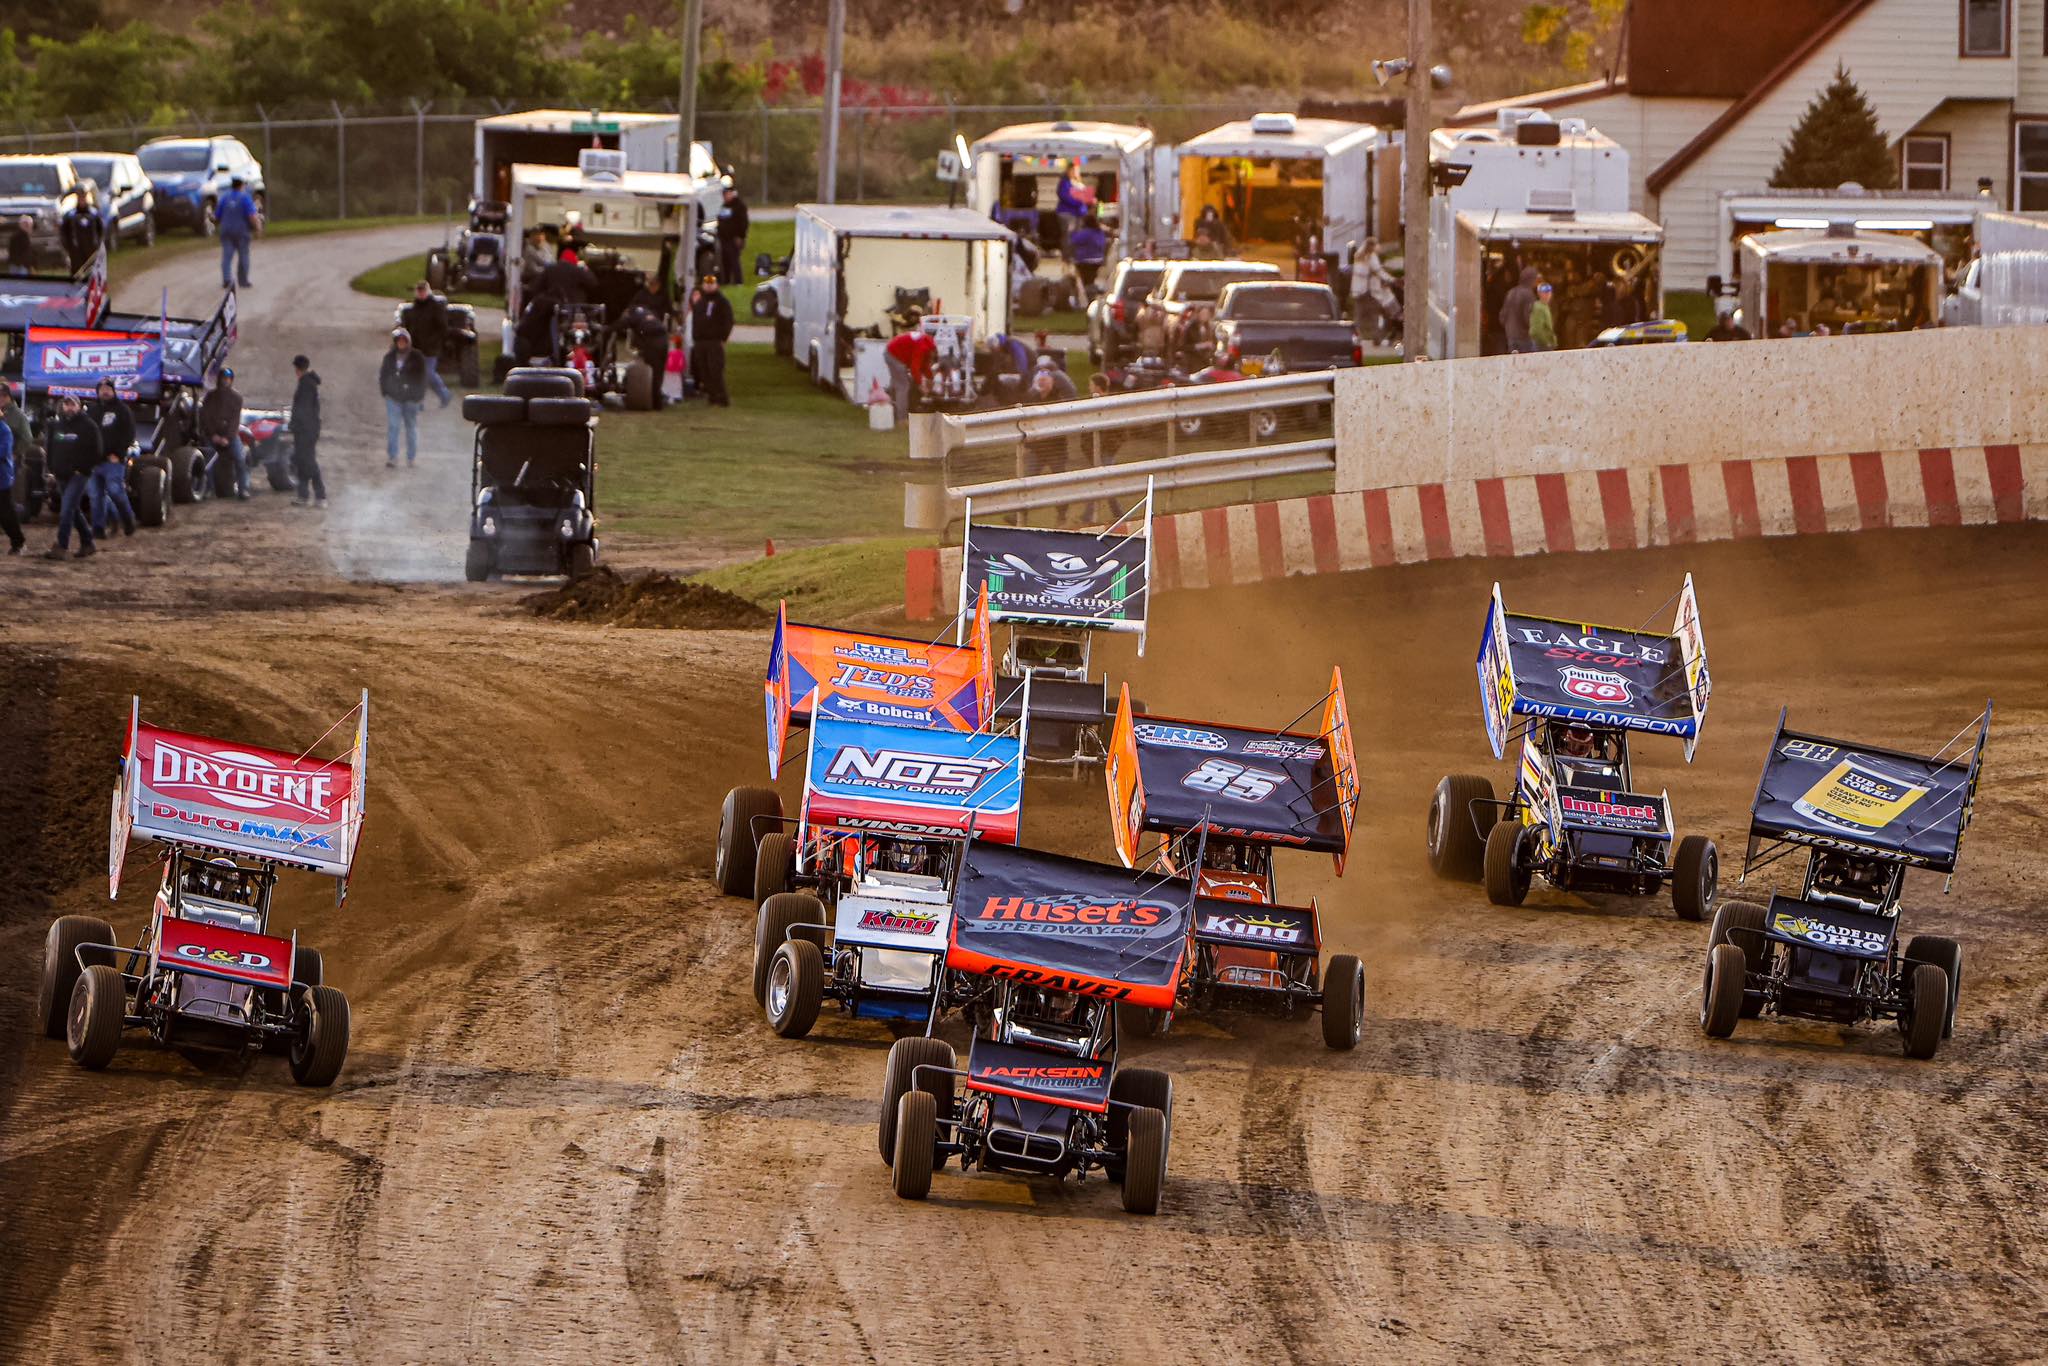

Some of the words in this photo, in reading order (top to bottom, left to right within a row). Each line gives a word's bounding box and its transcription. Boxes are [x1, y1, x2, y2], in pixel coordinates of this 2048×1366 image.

[42, 343, 154, 368] NOS
[988, 592, 1052, 604] YOUNG
[1069, 597, 1124, 609] GUNS
[1518, 628, 1665, 665] EAGLE
[1544, 647, 1642, 667] Stop
[1569, 670, 1621, 684] PHILLIPS
[1574, 682, 1618, 697] 66
[866, 702, 932, 721] Bobcat
[1522, 703, 1688, 734] WILLIAMSON
[1153, 727, 1212, 742] HRP
[153, 743, 331, 814] DRYDENE
[825, 746, 1008, 789] NOS
[824, 776, 905, 790] ENERGY
[907, 786, 973, 797] DRINK
[1180, 757, 1290, 803] 85
[1843, 777, 1898, 801] TOWELS
[1848, 772, 1876, 788] TUB
[1562, 796, 1657, 820] Impact
[1826, 793, 1851, 805] WIPES
[1830, 789, 1872, 808] CLEANING
[1833, 786, 1861, 800] HEAVY
[1860, 796, 1885, 808] DUTY
[838, 817, 984, 840] WINDOM
[978, 896, 1161, 925] Huset's
[858, 910, 940, 935] King
[984, 922, 1147, 936] SPEEDWAY.COM
[1809, 921, 1861, 938] MADE
[1863, 932, 1886, 943] IN
[1806, 930, 1884, 952] OHIO
[974, 1066, 1104, 1078] JACKSON
